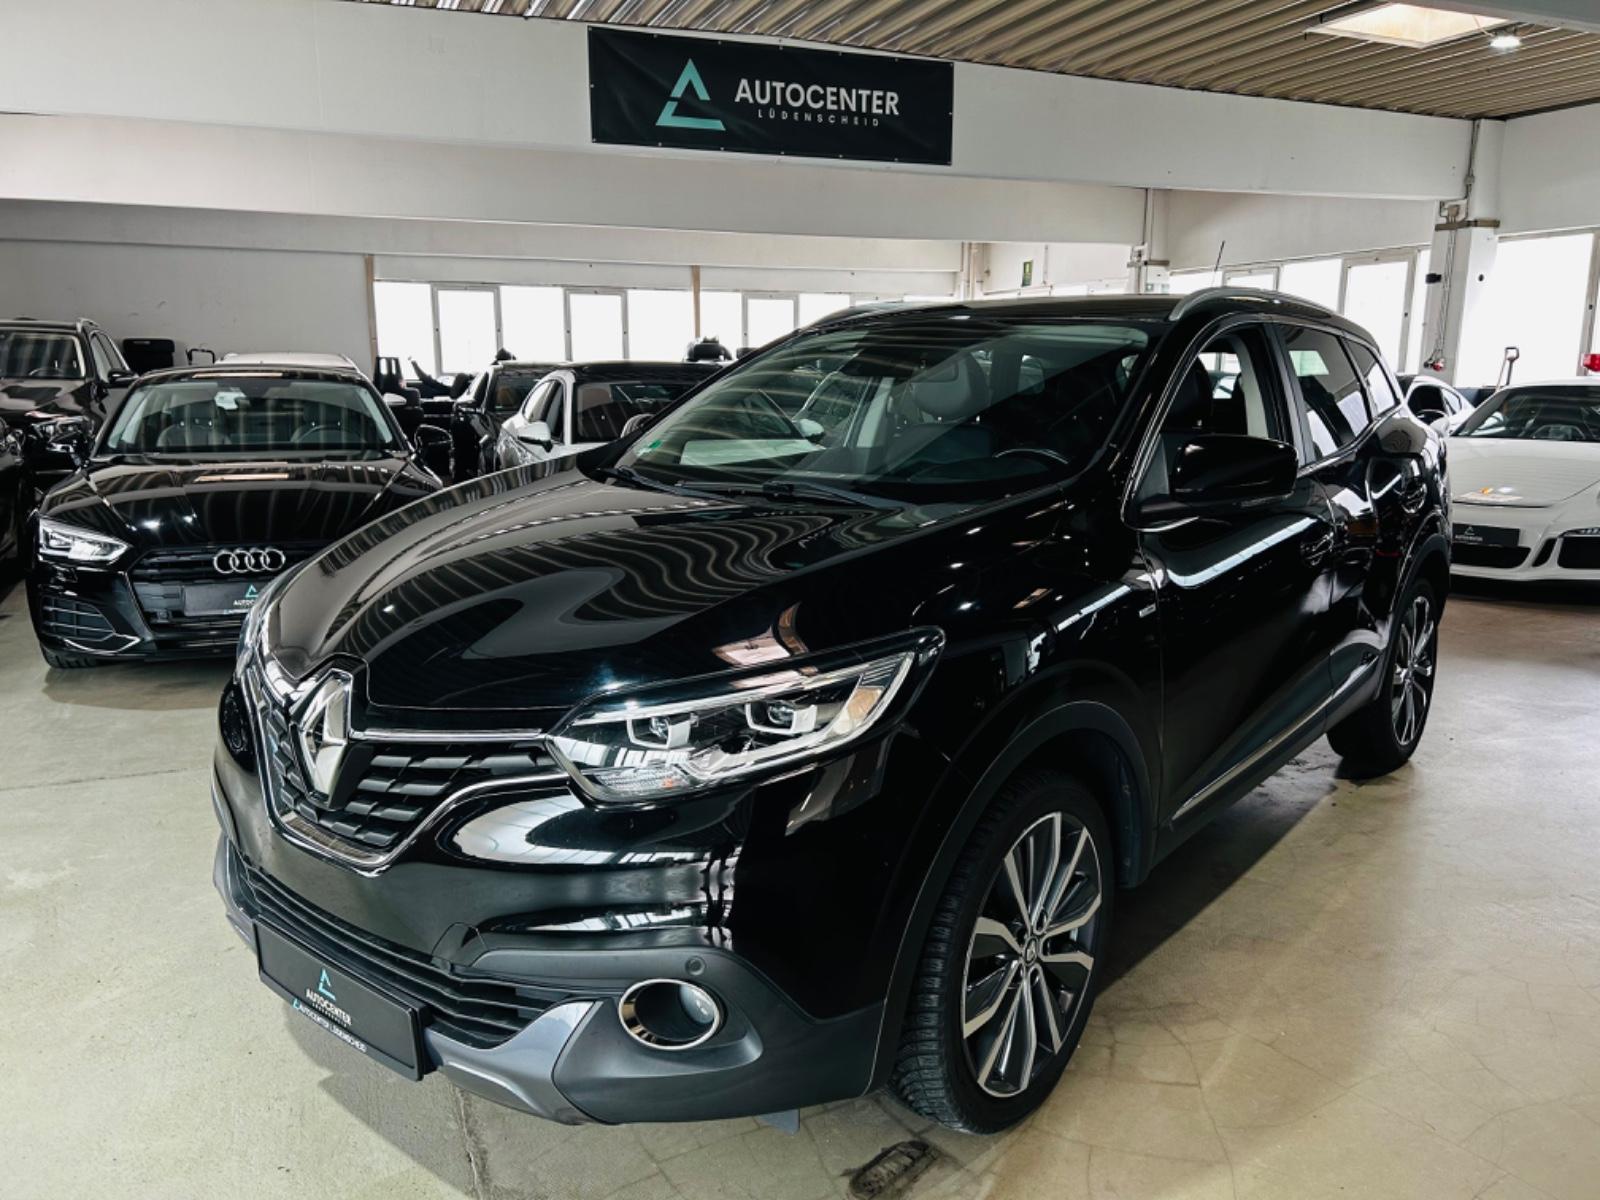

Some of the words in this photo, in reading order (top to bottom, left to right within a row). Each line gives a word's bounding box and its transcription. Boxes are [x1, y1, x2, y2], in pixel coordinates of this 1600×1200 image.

[734, 78, 900, 116] AUTOCENTER
[757, 107, 879, 127] LÜDENSCHEID
[305, 988, 352, 1027] AUTOCENTER
